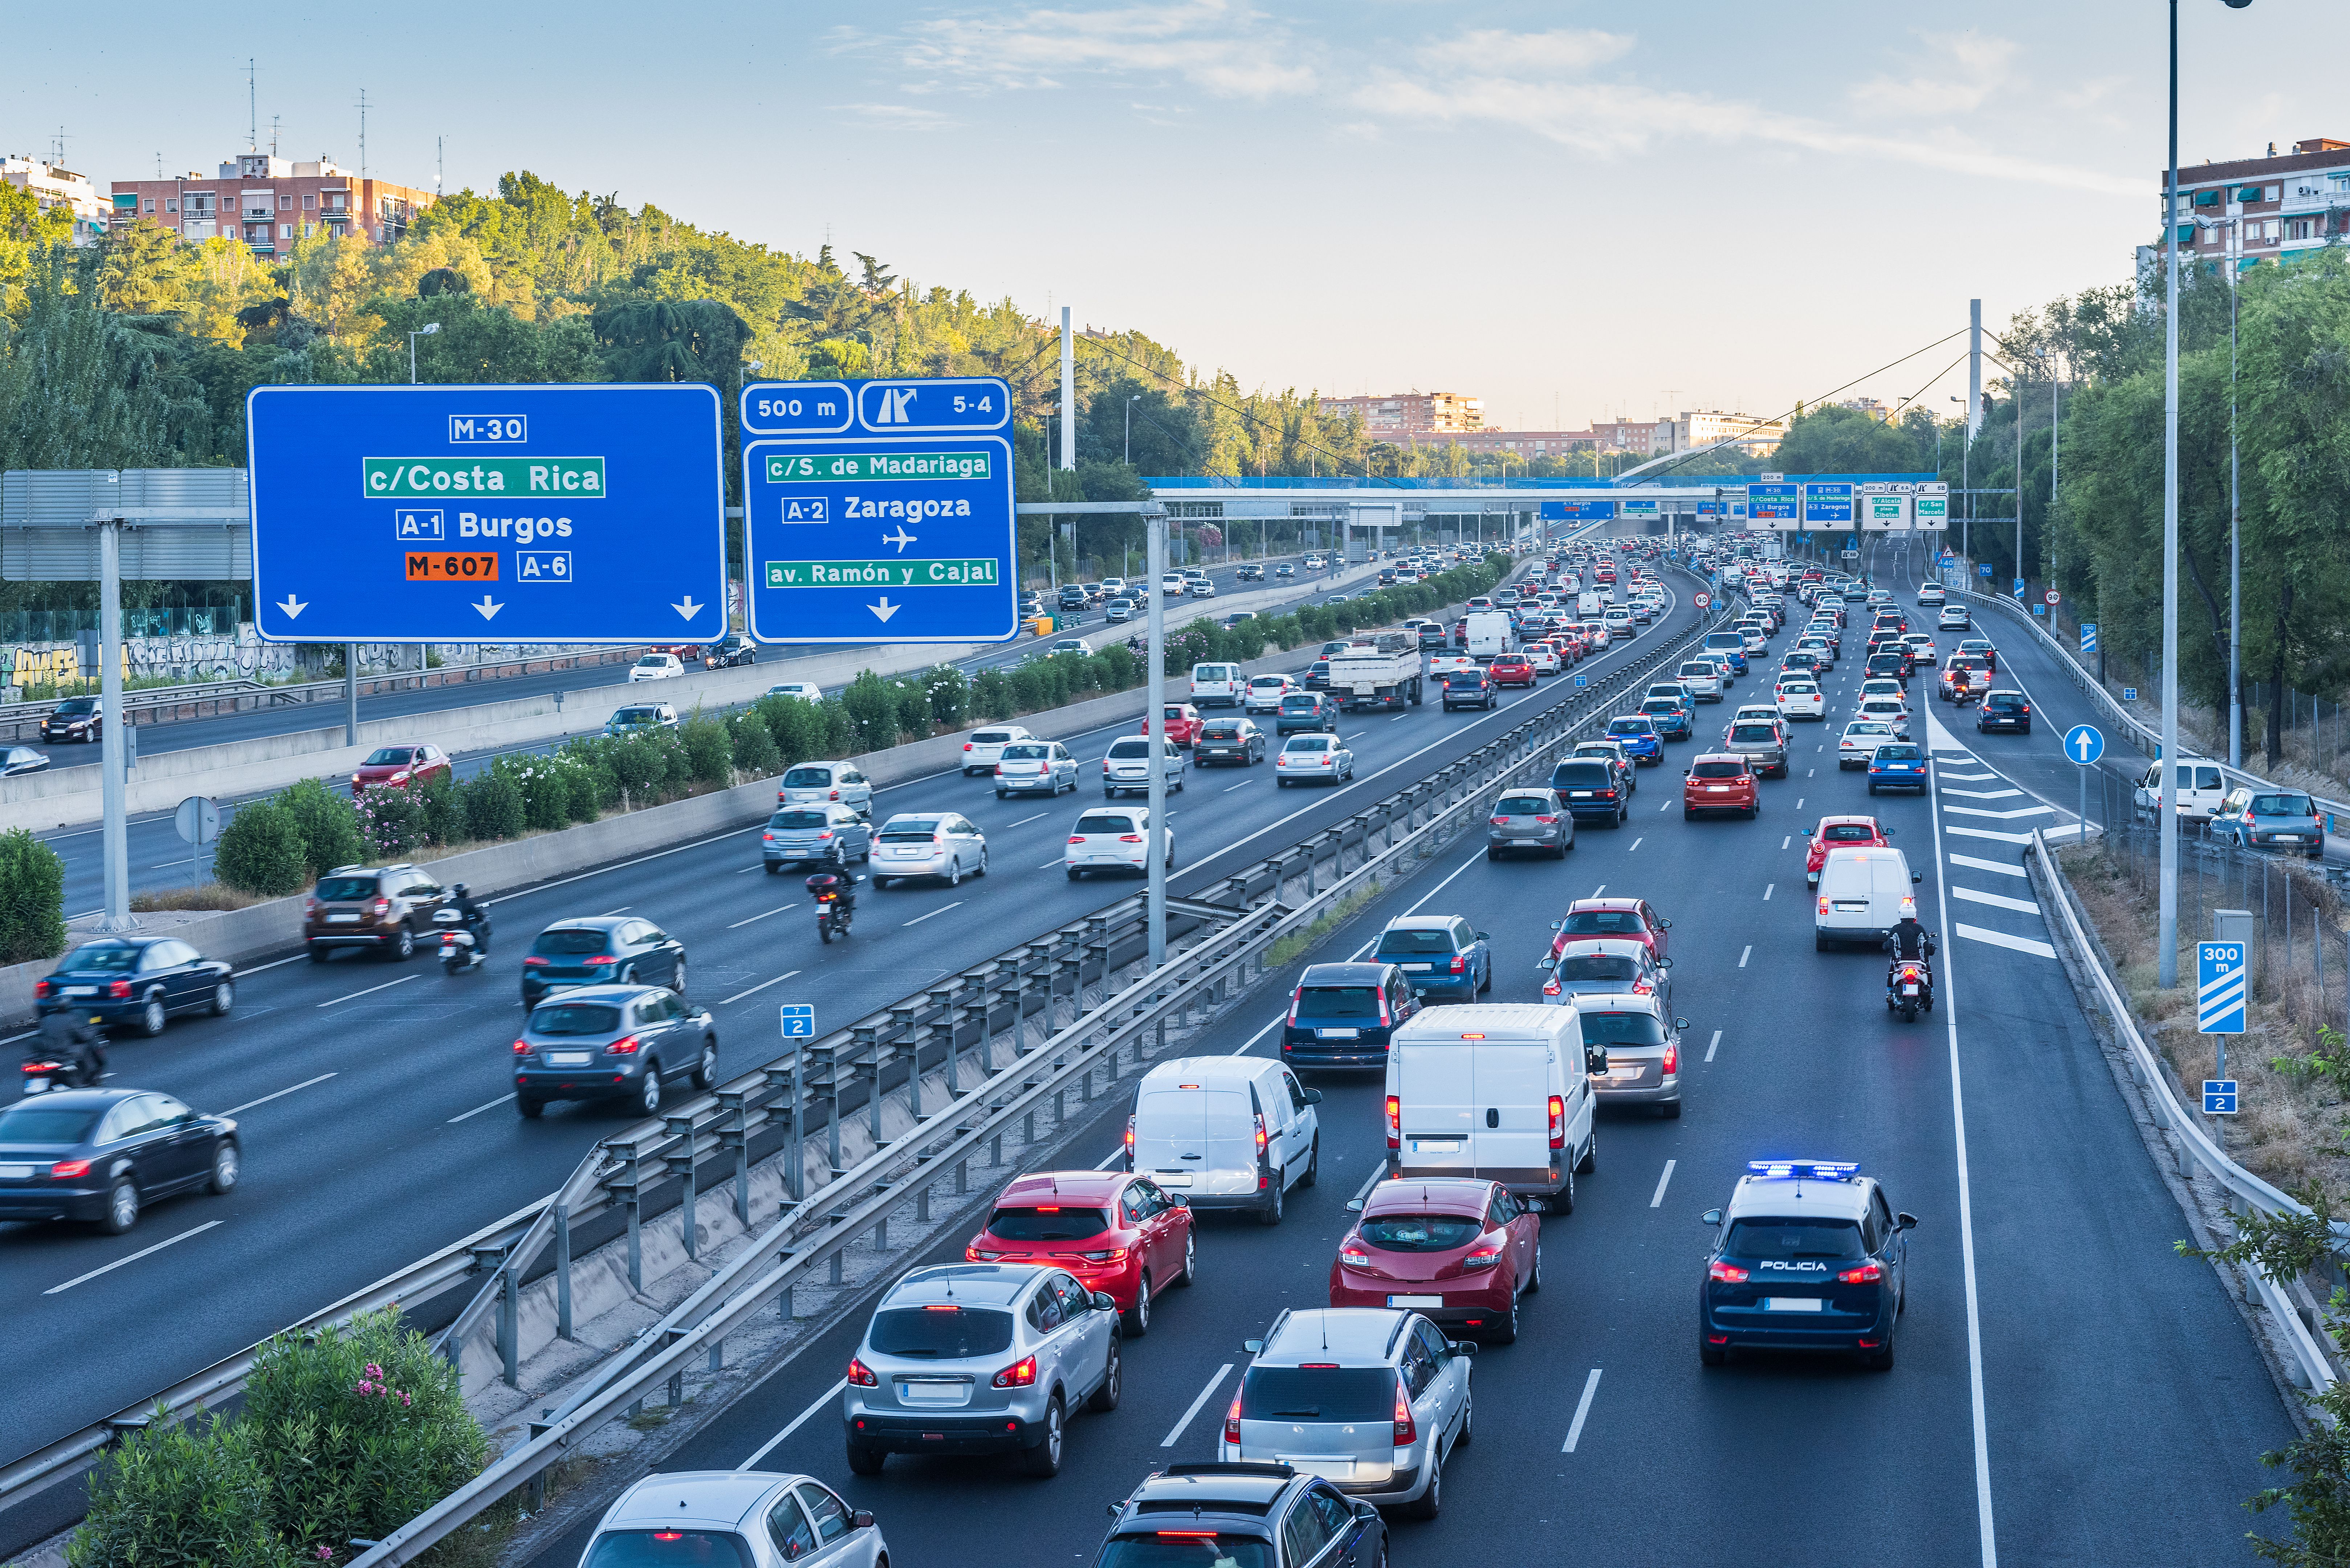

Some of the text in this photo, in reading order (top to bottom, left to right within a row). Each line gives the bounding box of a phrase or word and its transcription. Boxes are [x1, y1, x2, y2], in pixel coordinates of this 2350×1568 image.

[759, 400, 835, 416] 500 m
[954, 396, 991, 412] 5-4
[455, 420, 521, 439] M-30
[831, 458, 858, 475] de
[871, 456, 986, 477] Madariaga
[370, 465, 600, 490] c/Costa Rica
[788, 497, 971, 523] A-2 Zaragoza
[402, 513, 572, 544] A-1 Burgos
[410, 557, 566, 576] M-607 A-6
[771, 562, 993, 585] av. Ramón y Cajal
[2204, 948, 2237, 960] 300
[2216, 963, 2229, 972] m
[792, 1020, 803, 1033] 2
[2217, 1083, 2224, 1092] 7
[2215, 1098, 2225, 1109] 2
[1760, 1261, 1827, 1271] POLICÍA
